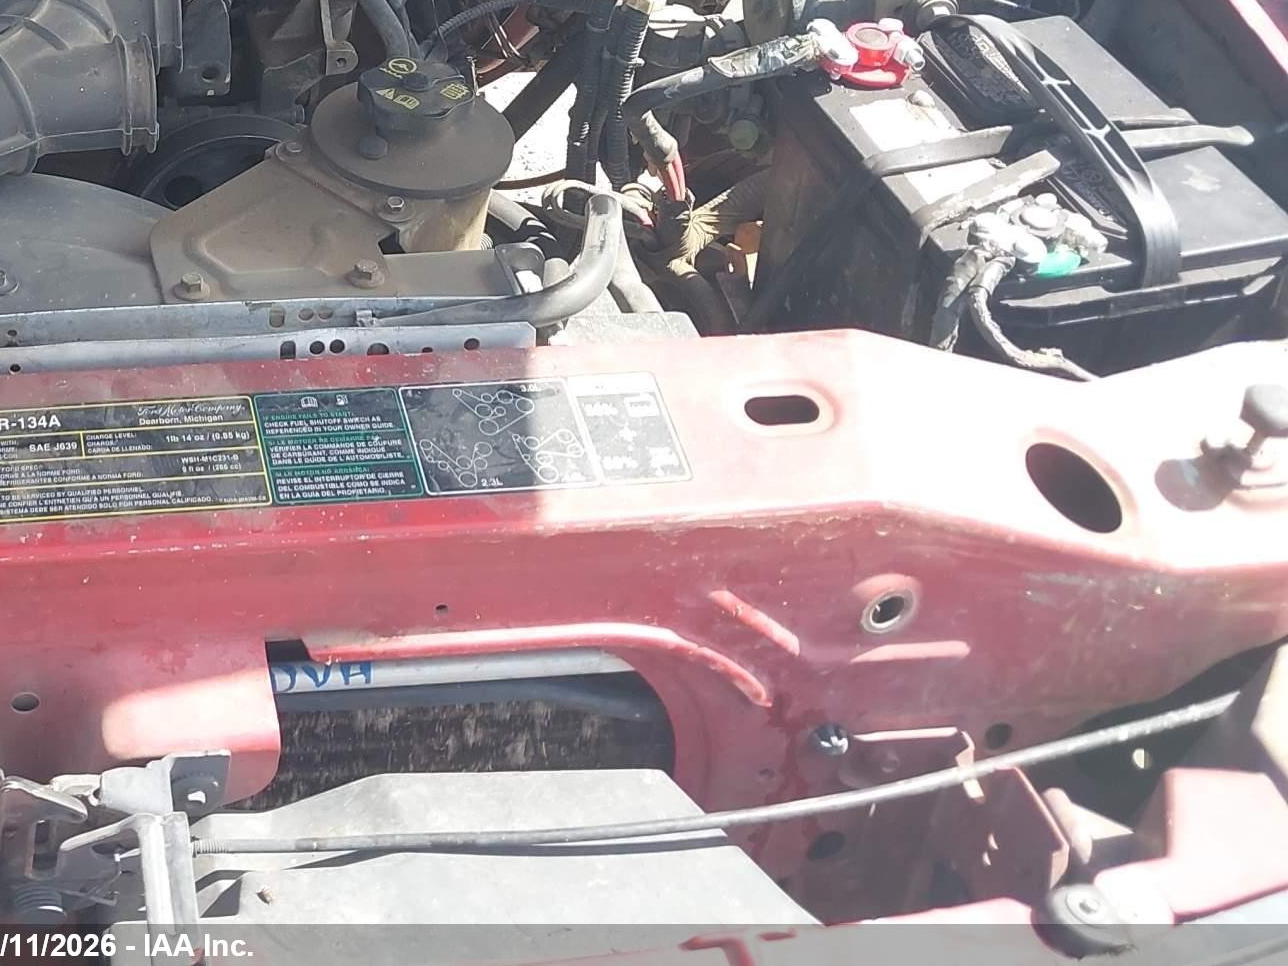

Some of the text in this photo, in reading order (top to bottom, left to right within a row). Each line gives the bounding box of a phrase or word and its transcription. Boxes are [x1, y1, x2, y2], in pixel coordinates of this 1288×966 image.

[183, 414, 223, 424] Michigan
[234, 430, 250, 439] kg)
[29, 442, 77, 451] SAE J639
[480, 477, 503, 486] 2.3L
